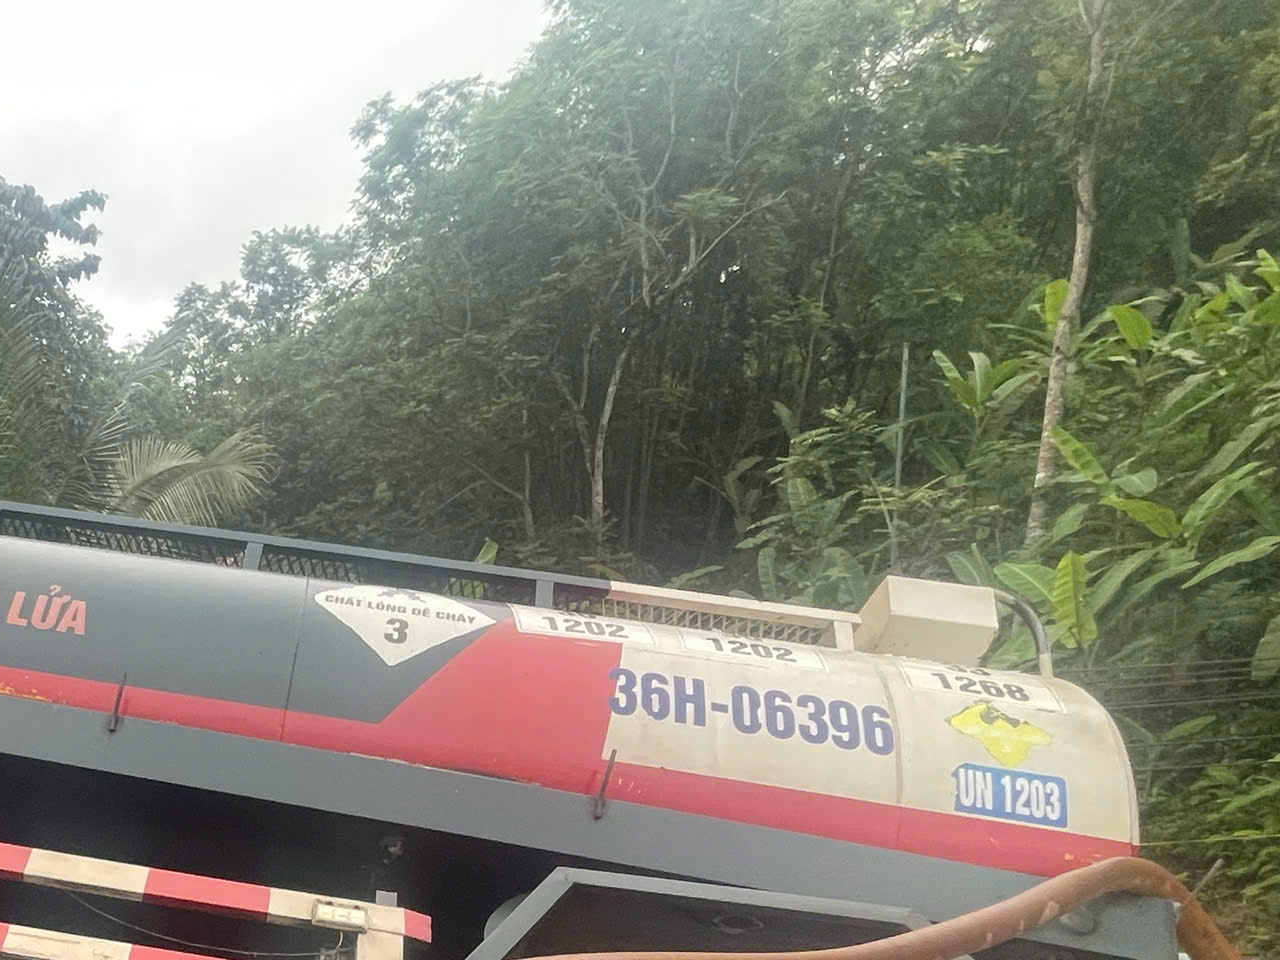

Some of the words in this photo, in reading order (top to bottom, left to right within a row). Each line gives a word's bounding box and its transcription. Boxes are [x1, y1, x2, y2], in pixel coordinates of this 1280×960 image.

[6, 584, 86, 635] LỬA
[384, 618, 409, 644] 3
[541, 616, 630, 639] 1202
[705, 637, 798, 663] 1202
[930, 673, 1031, 702] 1268
[608, 668, 895, 756] 36H-06396
[958, 768, 993, 811] UN
[1000, 775, 1061, 821] 1203
